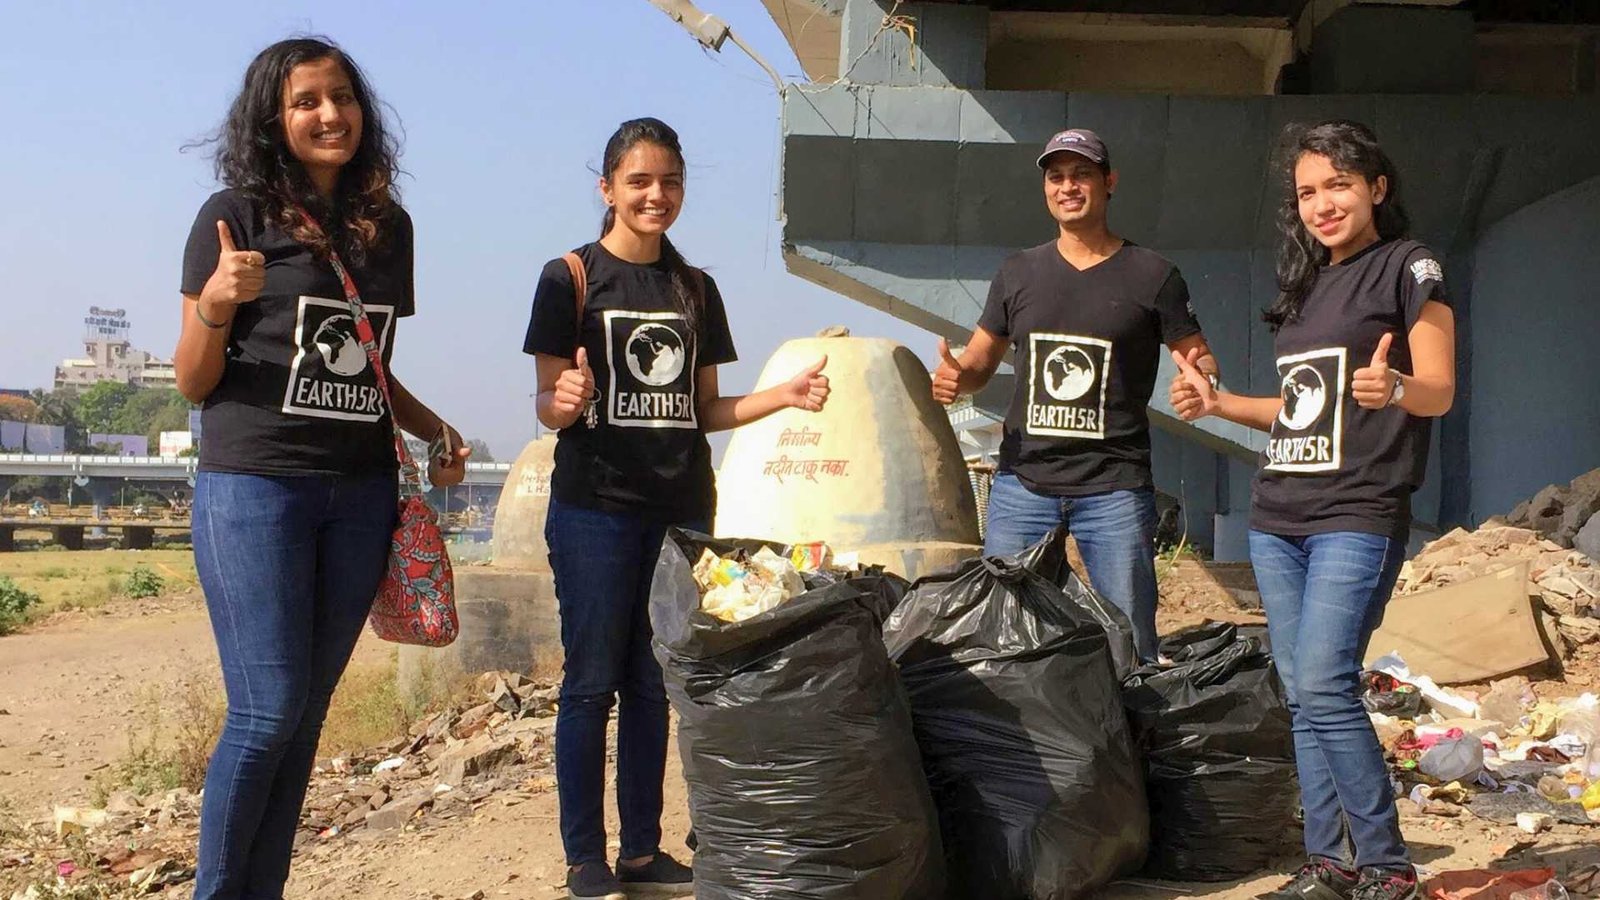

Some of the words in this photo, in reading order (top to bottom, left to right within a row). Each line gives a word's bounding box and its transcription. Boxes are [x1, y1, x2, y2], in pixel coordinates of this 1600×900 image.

[295, 377, 379, 412] EARTH5R
[616, 391, 690, 418] EARTH5R
[1031, 404, 1097, 430] EARTH5R
[1268, 435, 1331, 463] EARTH5R
